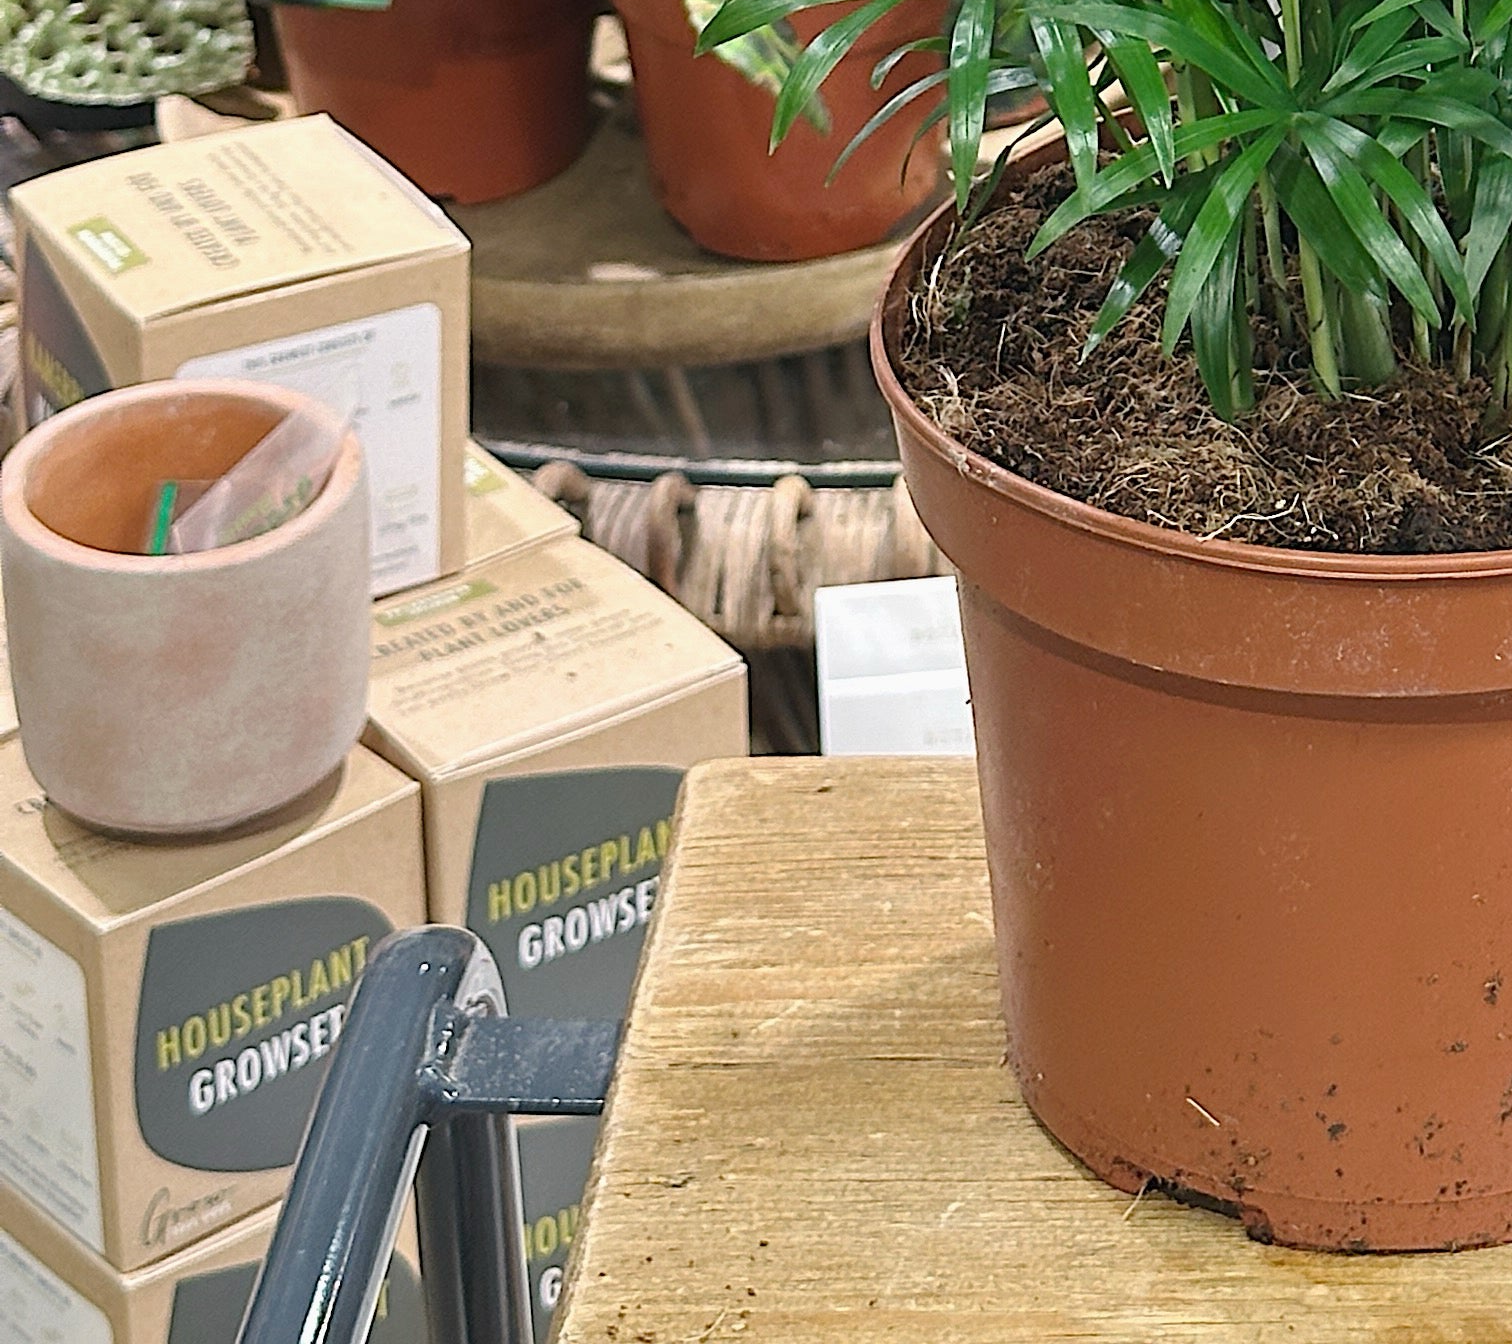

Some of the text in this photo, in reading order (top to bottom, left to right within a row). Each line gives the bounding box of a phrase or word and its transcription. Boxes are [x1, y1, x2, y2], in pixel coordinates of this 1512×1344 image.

[371, 622, 456, 659] REATED
[487, 815, 675, 924] HOUSEPLAN
[518, 875, 660, 969] GROWSE
[156, 935, 370, 1070] HOUSEPLANT
[189, 1003, 346, 1114] GROWSET
